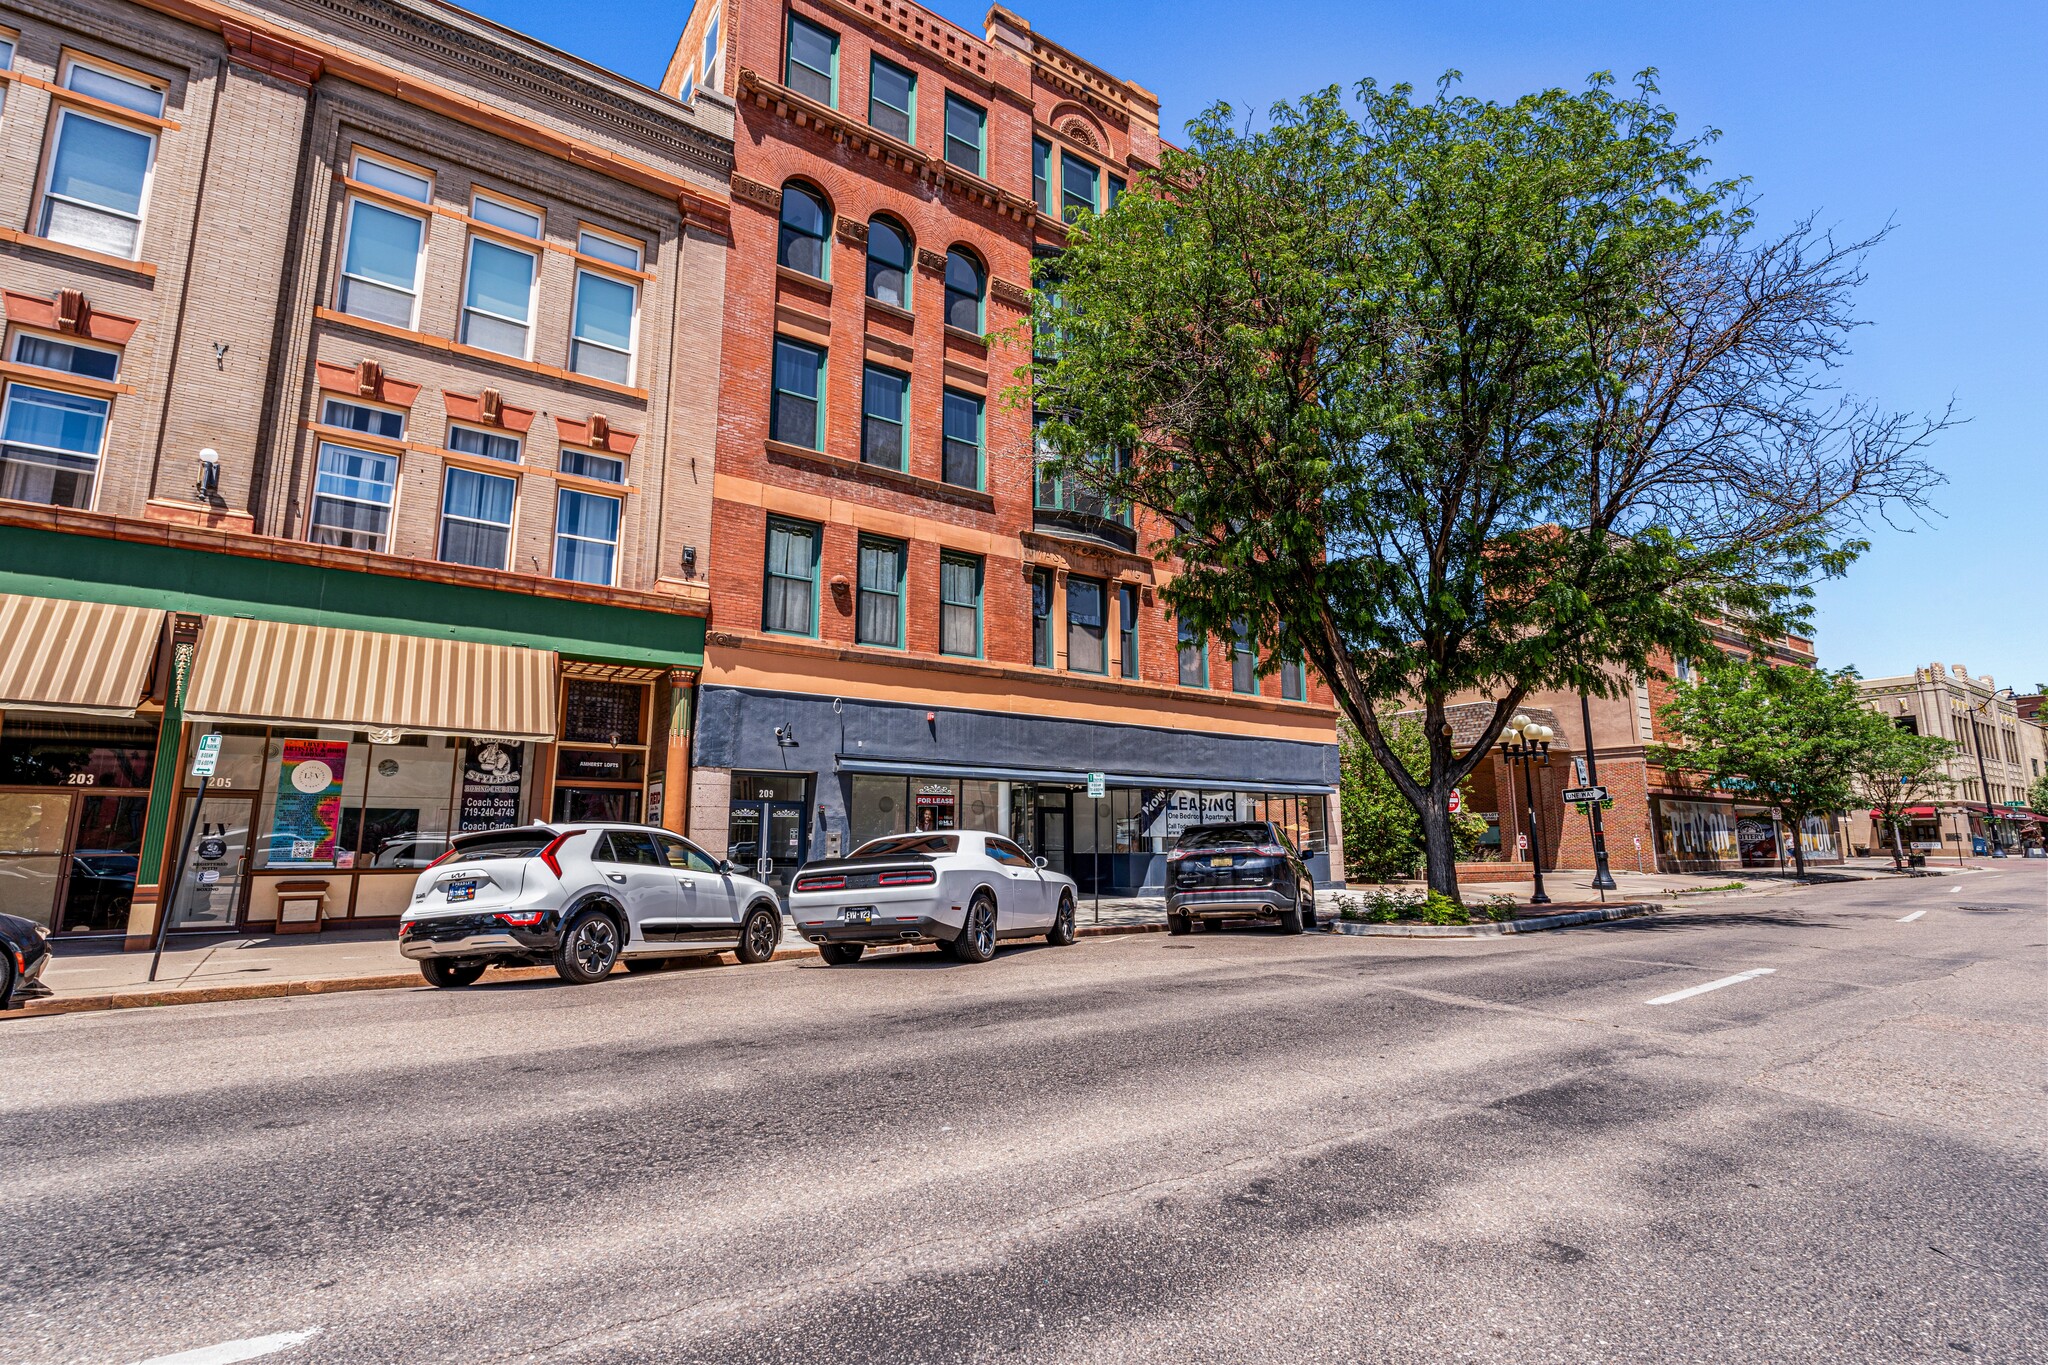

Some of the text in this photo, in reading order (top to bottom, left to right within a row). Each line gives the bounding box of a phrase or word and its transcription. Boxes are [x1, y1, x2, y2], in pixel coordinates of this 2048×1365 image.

[68, 774, 94, 785] 203
[209, 776, 231, 788] 205
[465, 770, 521, 784] STYLERS
[759, 789, 774, 798] 209
[467, 798, 514, 807] Coach Scott
[1142, 787, 1166, 815] NOW
[1167, 797, 1234, 811] LEASING
[464, 807, 515, 817] 719-240-4749
[462, 822, 514, 831] Coach Carlos
[1670, 811, 1730, 853] PLAY ON
